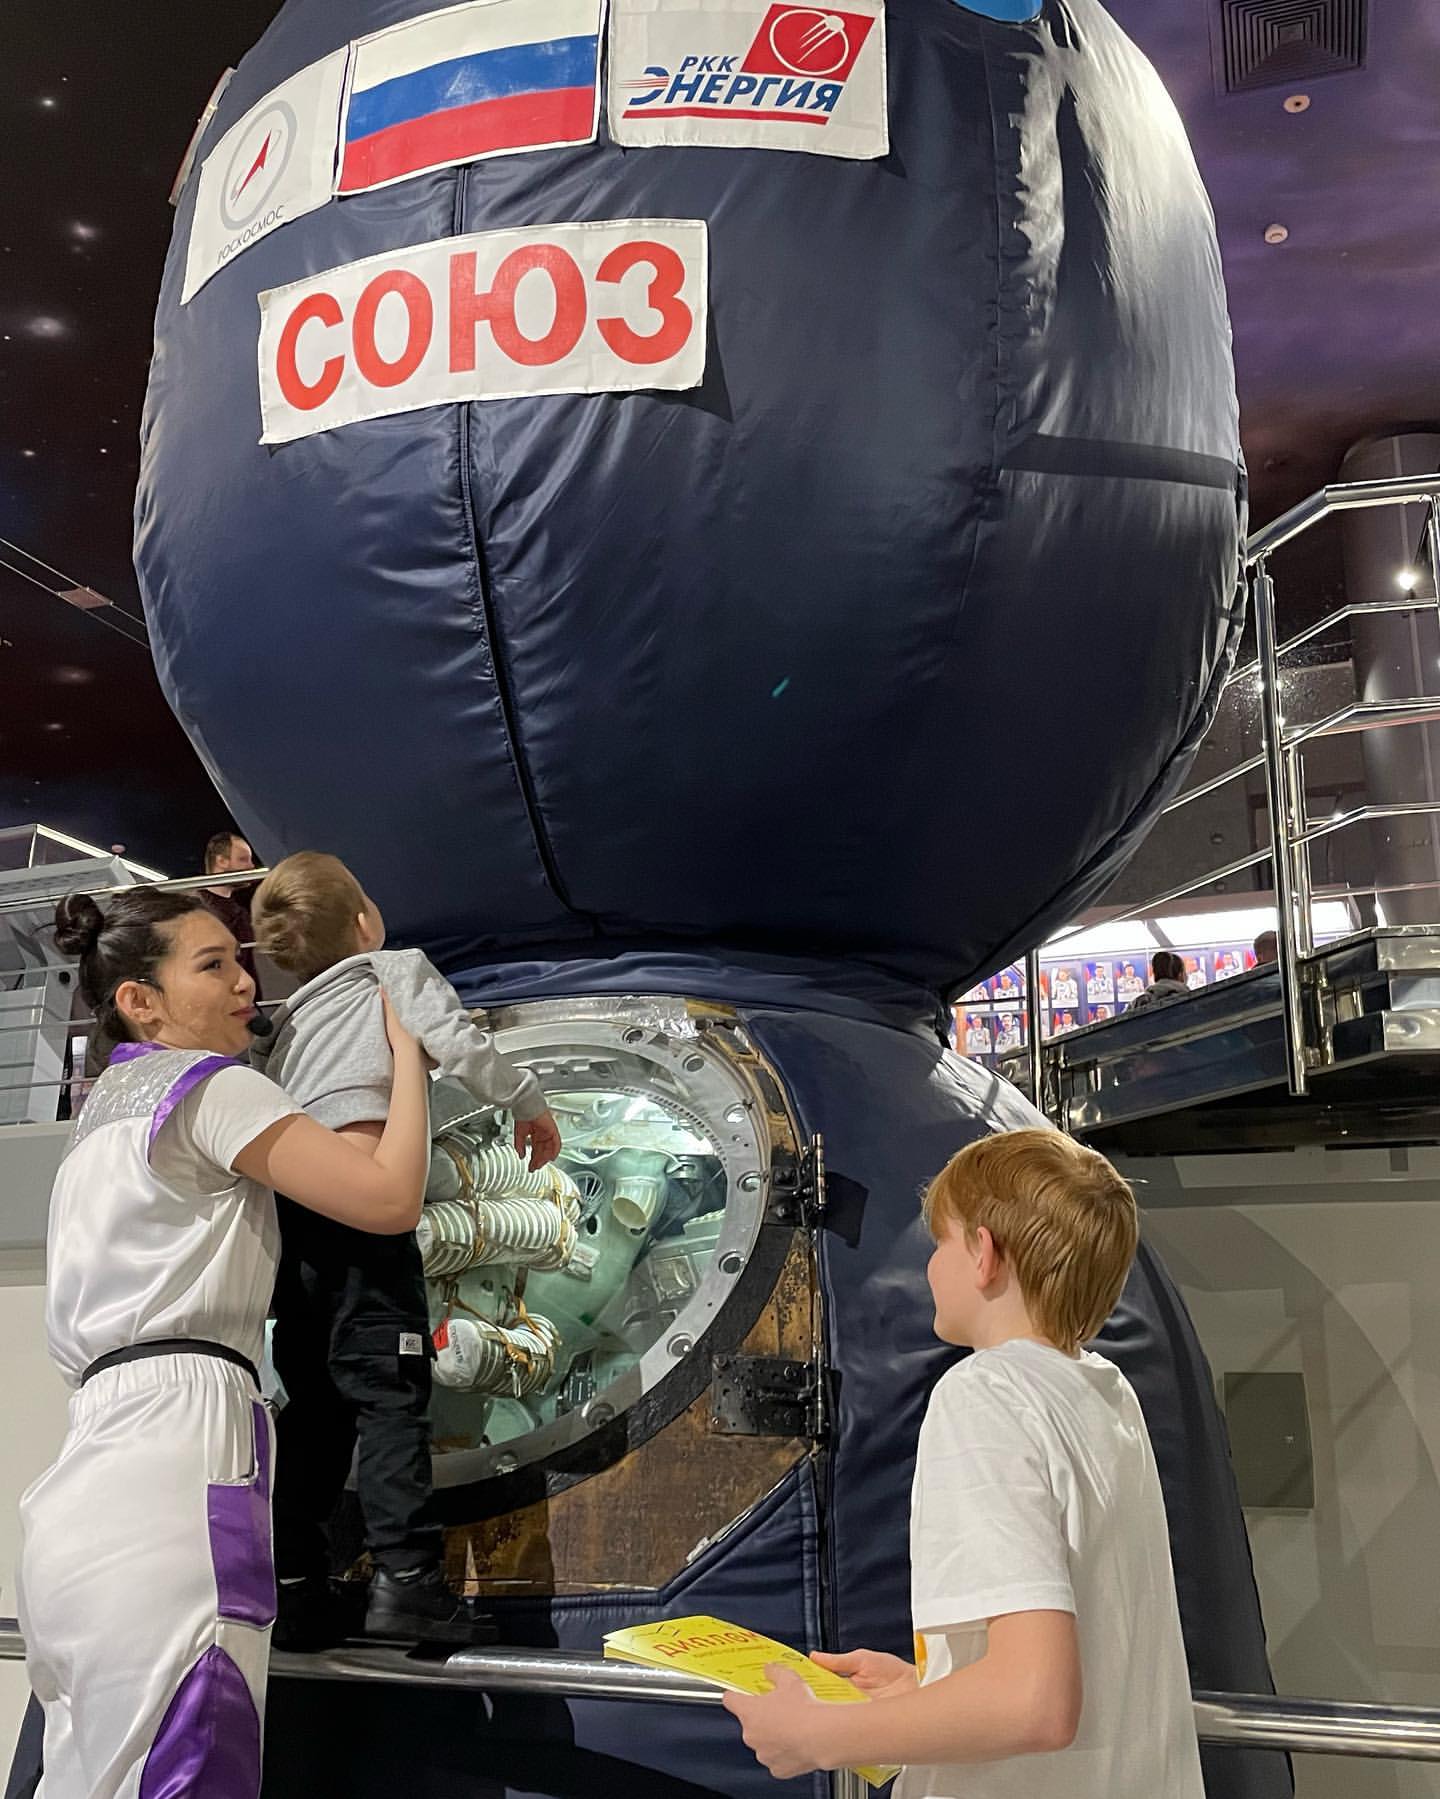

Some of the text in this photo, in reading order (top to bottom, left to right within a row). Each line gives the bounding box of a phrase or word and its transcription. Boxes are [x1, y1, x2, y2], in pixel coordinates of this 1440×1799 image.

[679, 55, 741, 73] РКК
[627, 66, 844, 112] ЭНЕРГИЯ
[276, 240, 693, 411] СОЮЗ
